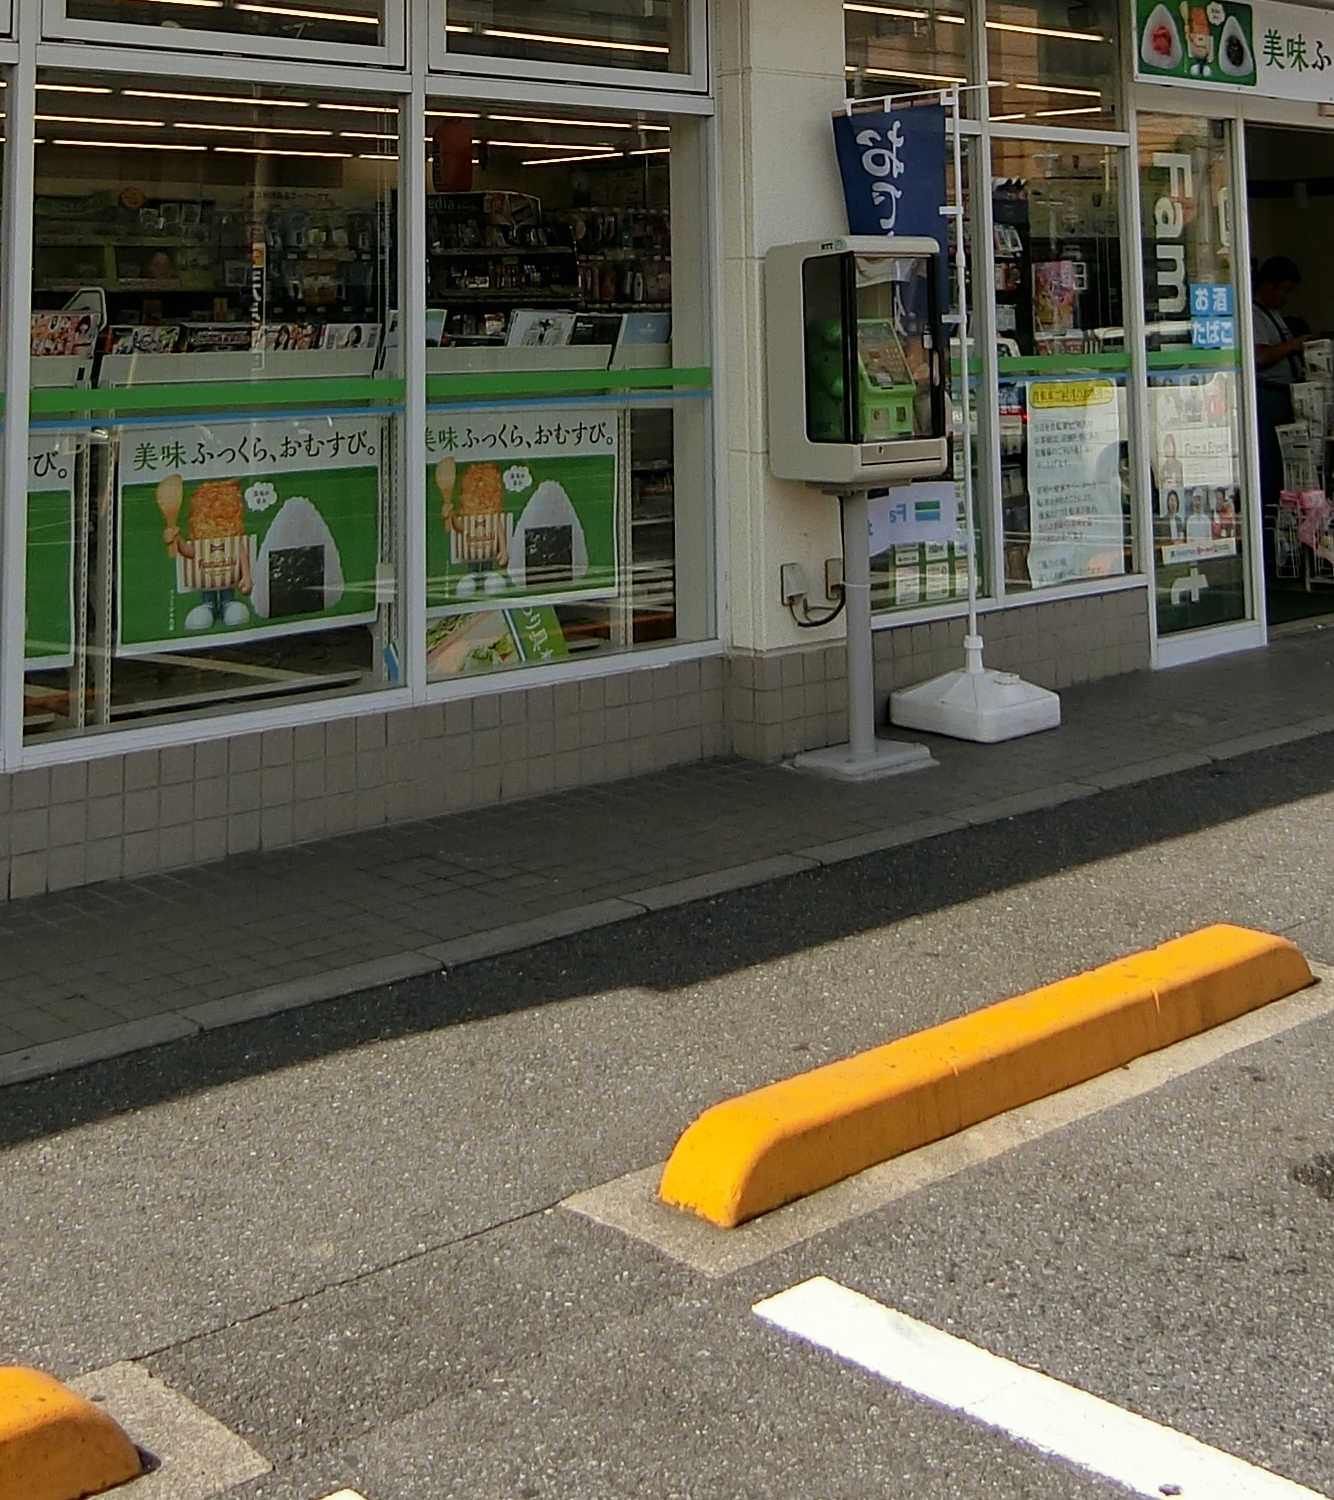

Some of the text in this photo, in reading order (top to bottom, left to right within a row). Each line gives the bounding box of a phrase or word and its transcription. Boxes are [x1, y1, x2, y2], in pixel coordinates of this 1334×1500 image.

[1194, 287, 1228, 312] お酒
[1192, 320, 1234, 346] たばこ
[133, 430, 375, 471] 美味ふっくら、おむすび。
